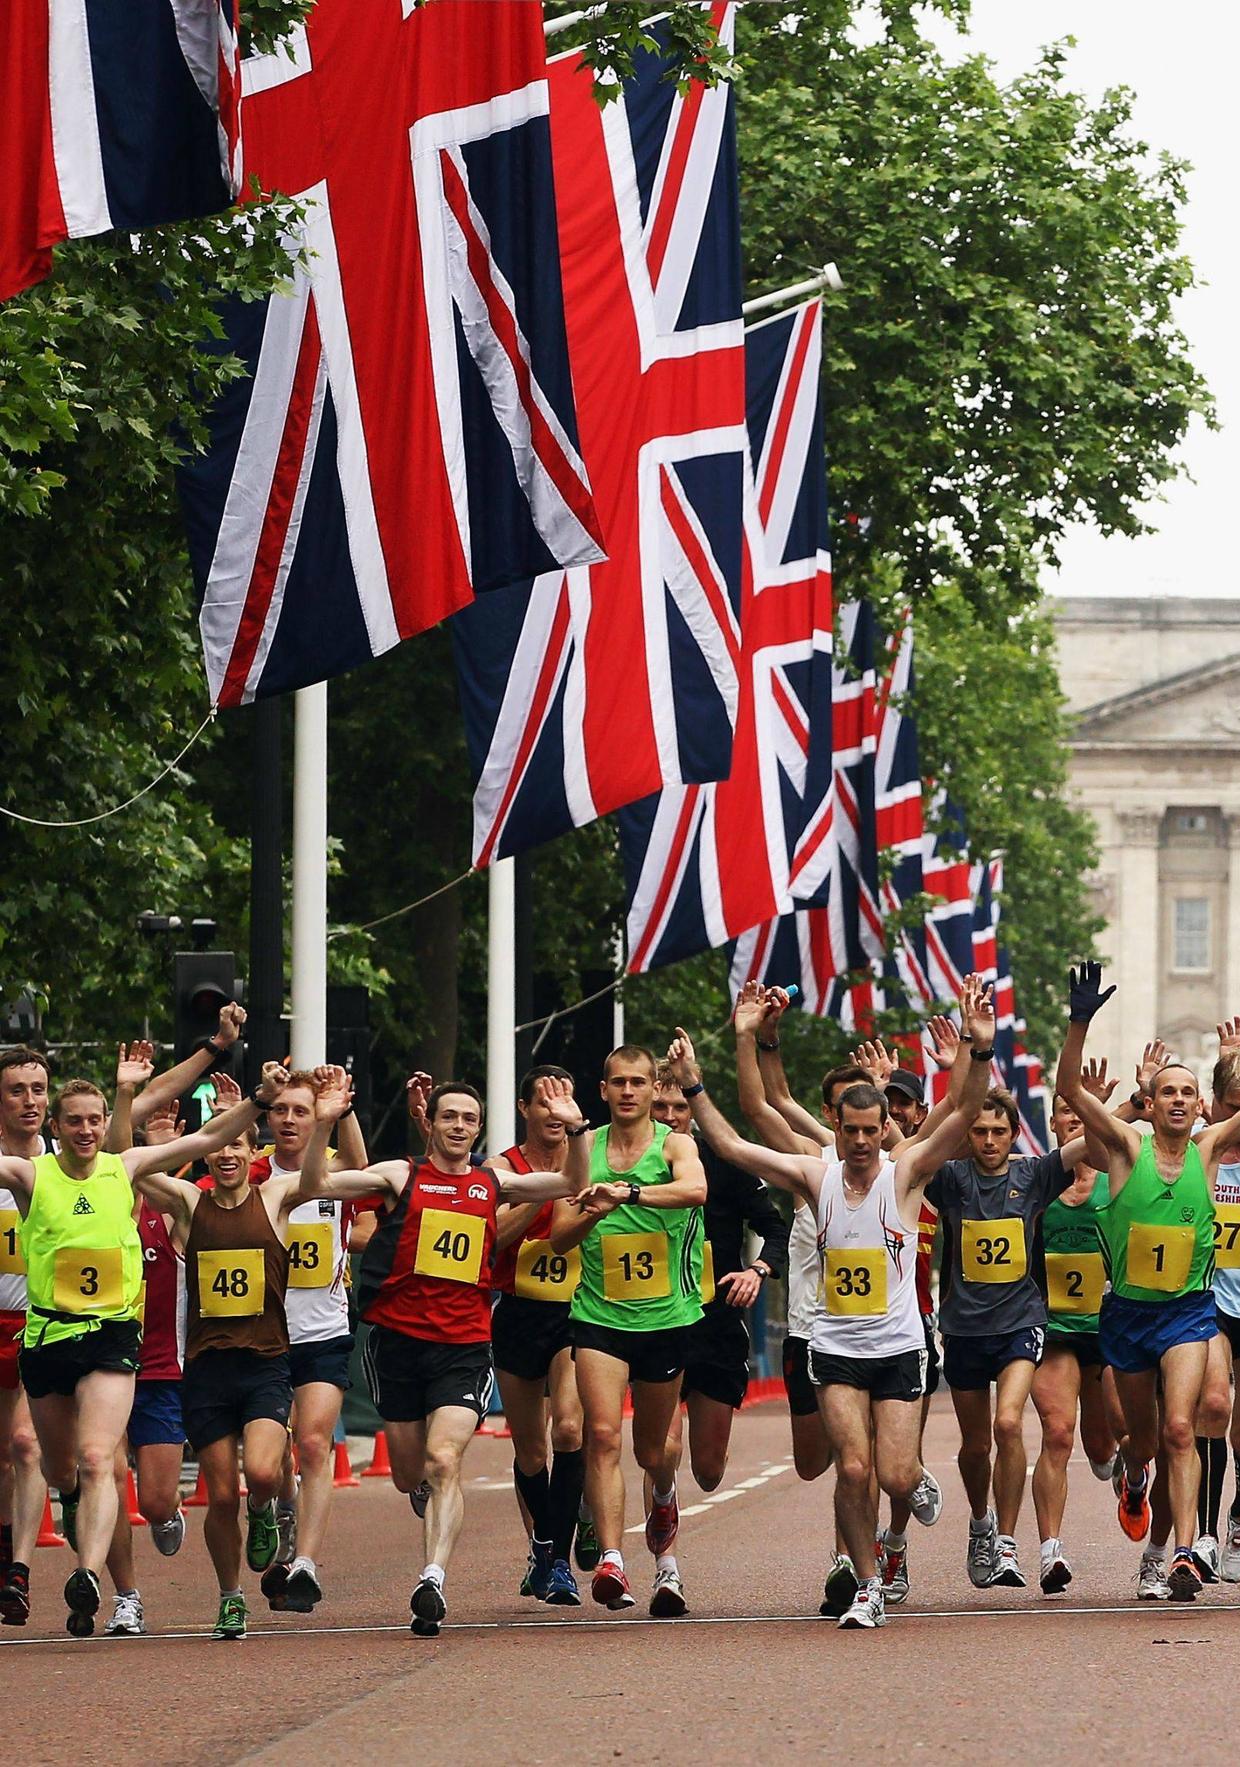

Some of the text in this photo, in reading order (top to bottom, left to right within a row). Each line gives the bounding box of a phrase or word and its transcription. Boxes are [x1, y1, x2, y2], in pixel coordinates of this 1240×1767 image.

[1213, 1184, 1240, 1194] OUTH
[434, 1231, 469, 1261] 40
[1212, 1222, 1240, 1250] 27
[143, 1247, 158, 1261] C
[288, 1241, 319, 1269] 43
[976, 1238, 1010, 1265] 32
[1152, 1244, 1164, 1272] 1
[529, 1253, 568, 1283] 49
[619, 1252, 653, 1281] 13
[80, 1267, 98, 1295] 3
[212, 1269, 248, 1297] 48
[836, 1267, 870, 1296] 33
[1066, 1271, 1083, 1297] 2
